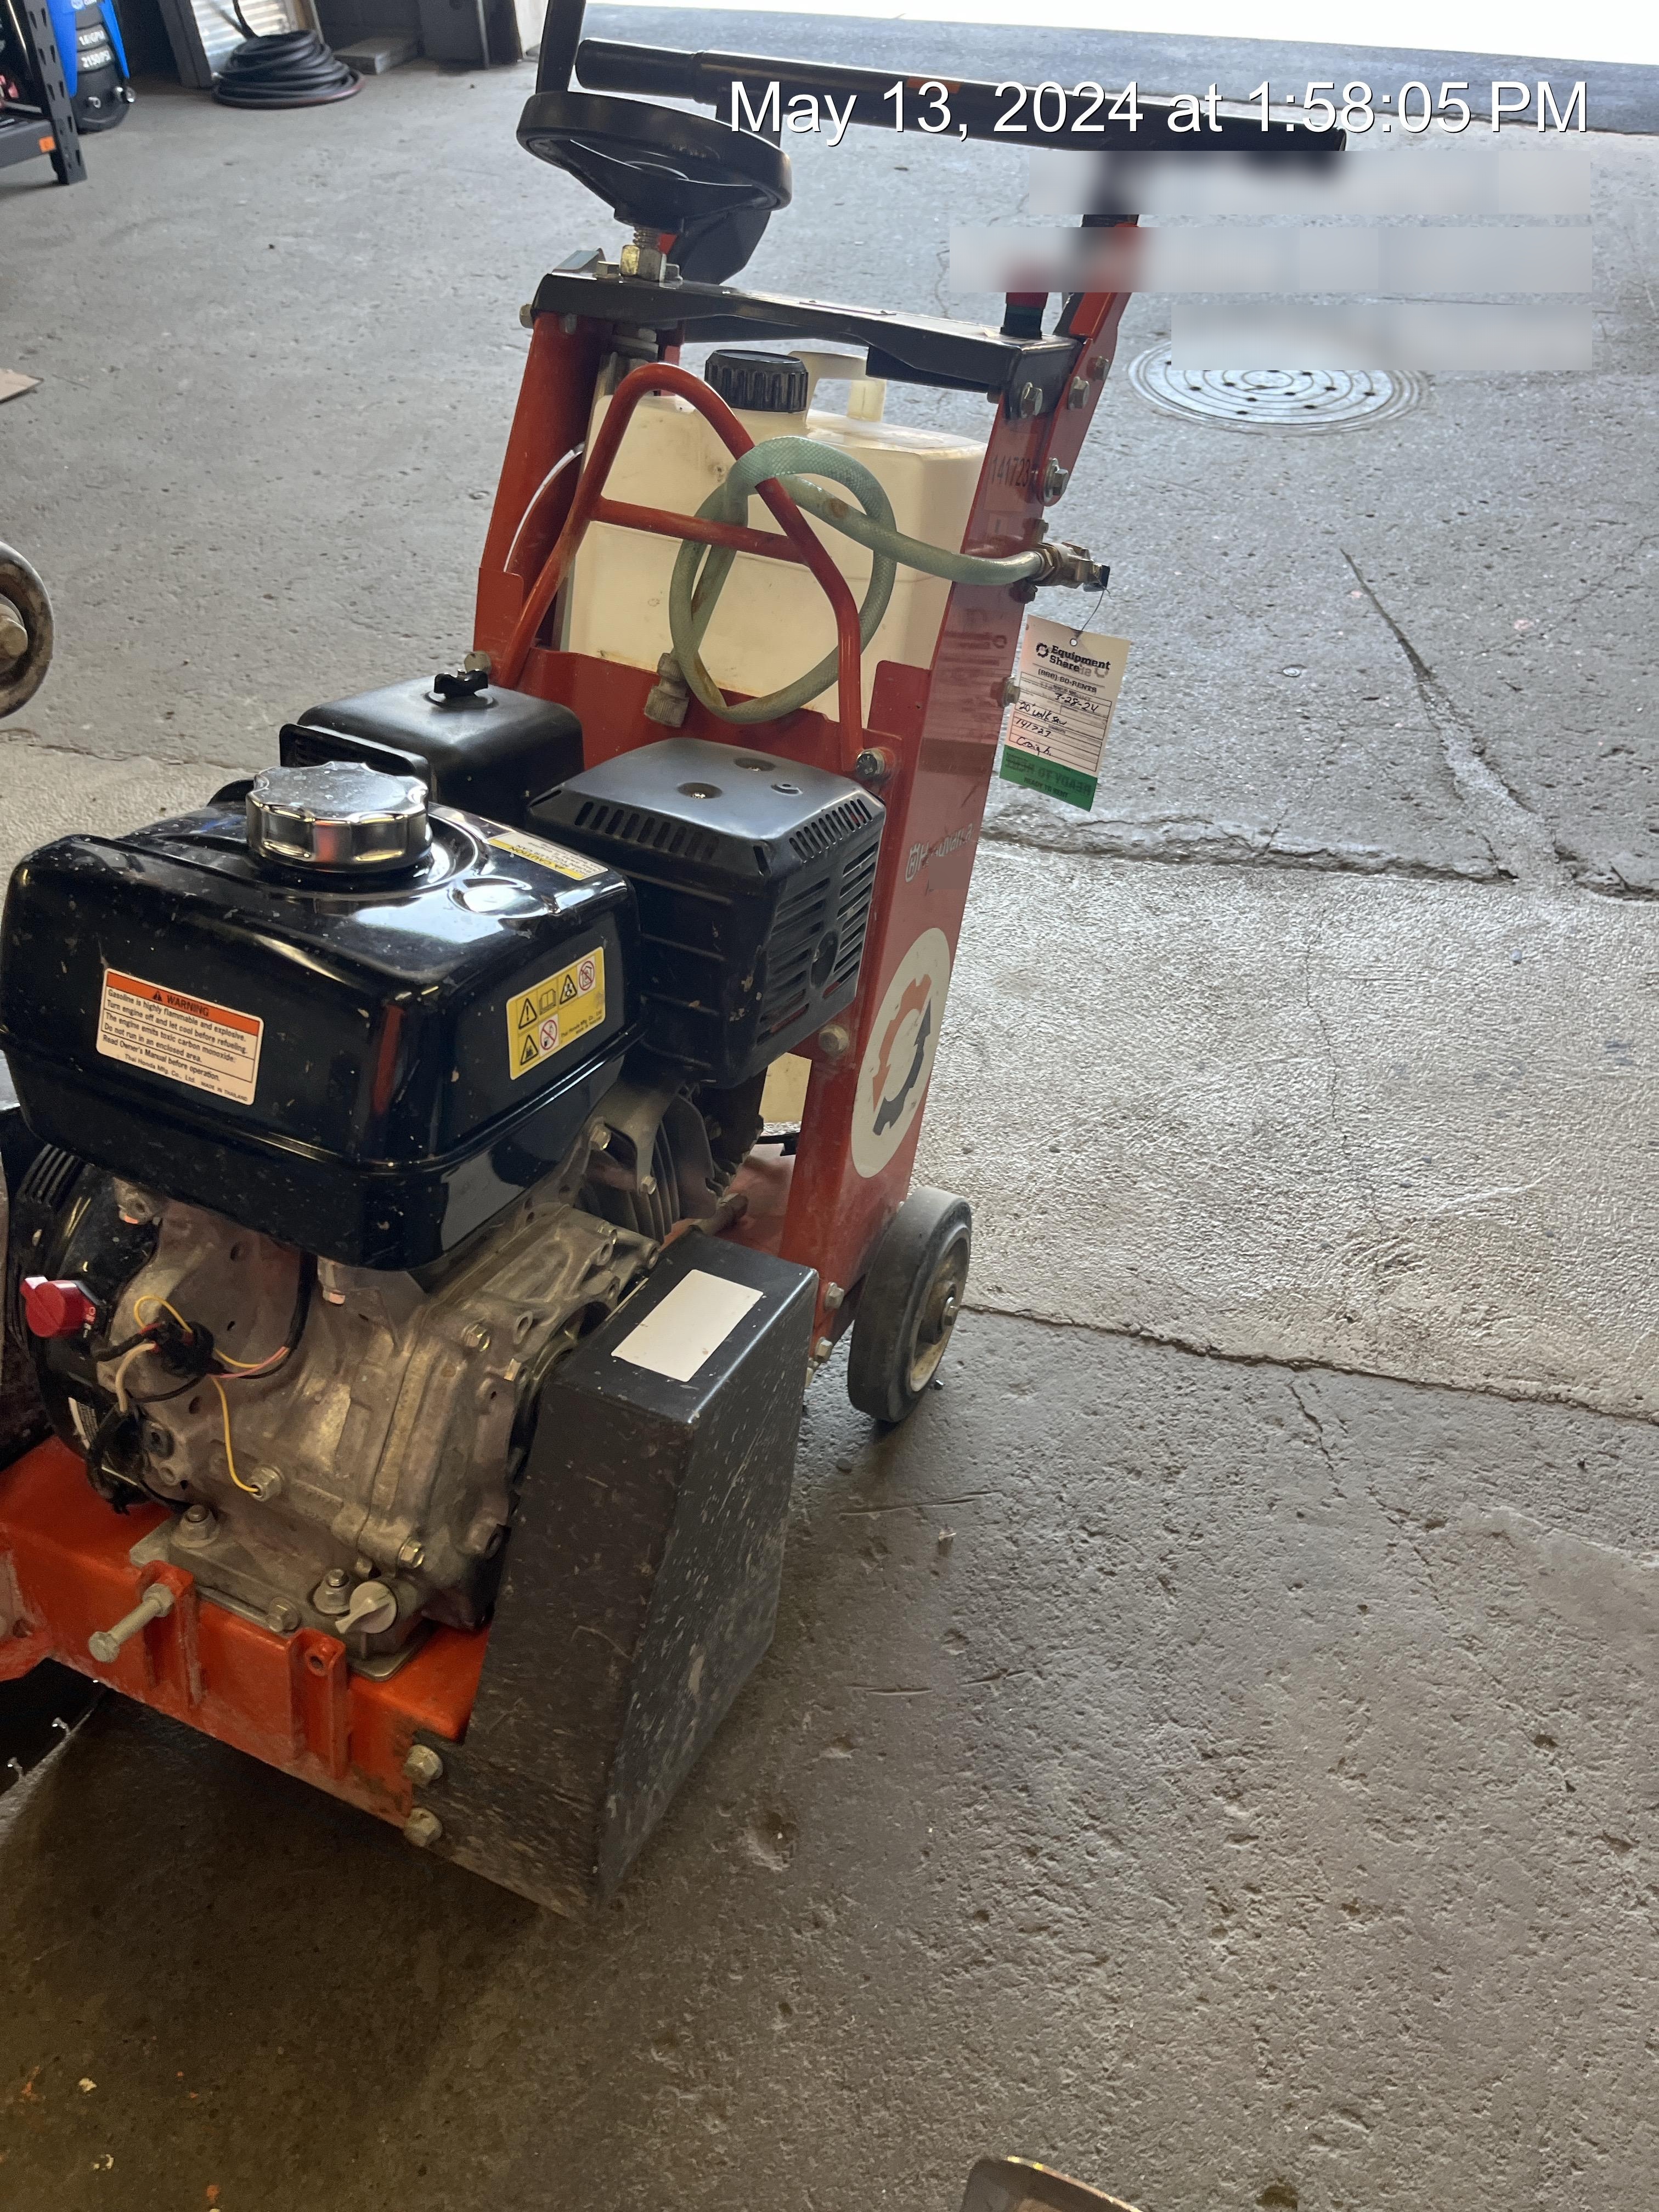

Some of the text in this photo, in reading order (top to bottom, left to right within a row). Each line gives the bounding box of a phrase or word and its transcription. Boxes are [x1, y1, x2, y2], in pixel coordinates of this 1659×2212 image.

[1049, 654, 1080, 672] Share
[1051, 645, 1111, 670] Equipment
[1059, 676, 1097, 693] 80-RENTS
[1016, 719, 1052, 737] 141723
[508, 846, 552, 865] CAUTION
[108, 989, 134, 1003] Gasoline
[143, 1000, 162, 1014] highly
[164, 1008, 198, 1025] flammable
[200, 1021, 212, 1031] and
[214, 1026, 246, 1042] explosive.
[167, 995, 210, 1017] WARNING
[106, 1012, 117, 1022] The
[119, 1018, 139, 1030] engine
[142, 1026, 158, 1036] emits
[160, 1031, 176, 1042] toxic
[178, 1037, 200, 1051] carbon
[108, 999, 121, 1010] Turn
[122, 1007, 143, 1018] engine
[155, 1018, 167, 1026] and
[169, 1020, 177, 1030] let
[179, 1025, 193, 1035] cool
[194, 1030, 216, 1043] before
[217, 1039, 248, 1054] refueling.
[104, 1022, 112, 1031] Do
[115, 1028, 125, 1036] not
[138, 1034, 144, 1042] in
[156, 1042, 184, 1056] enclosed
[186, 1052, 202, 1063] area.
[103, 1034, 220, 1081] Read Owner's Manual before operation.
[138, 1058, 156, 1069] Honda
